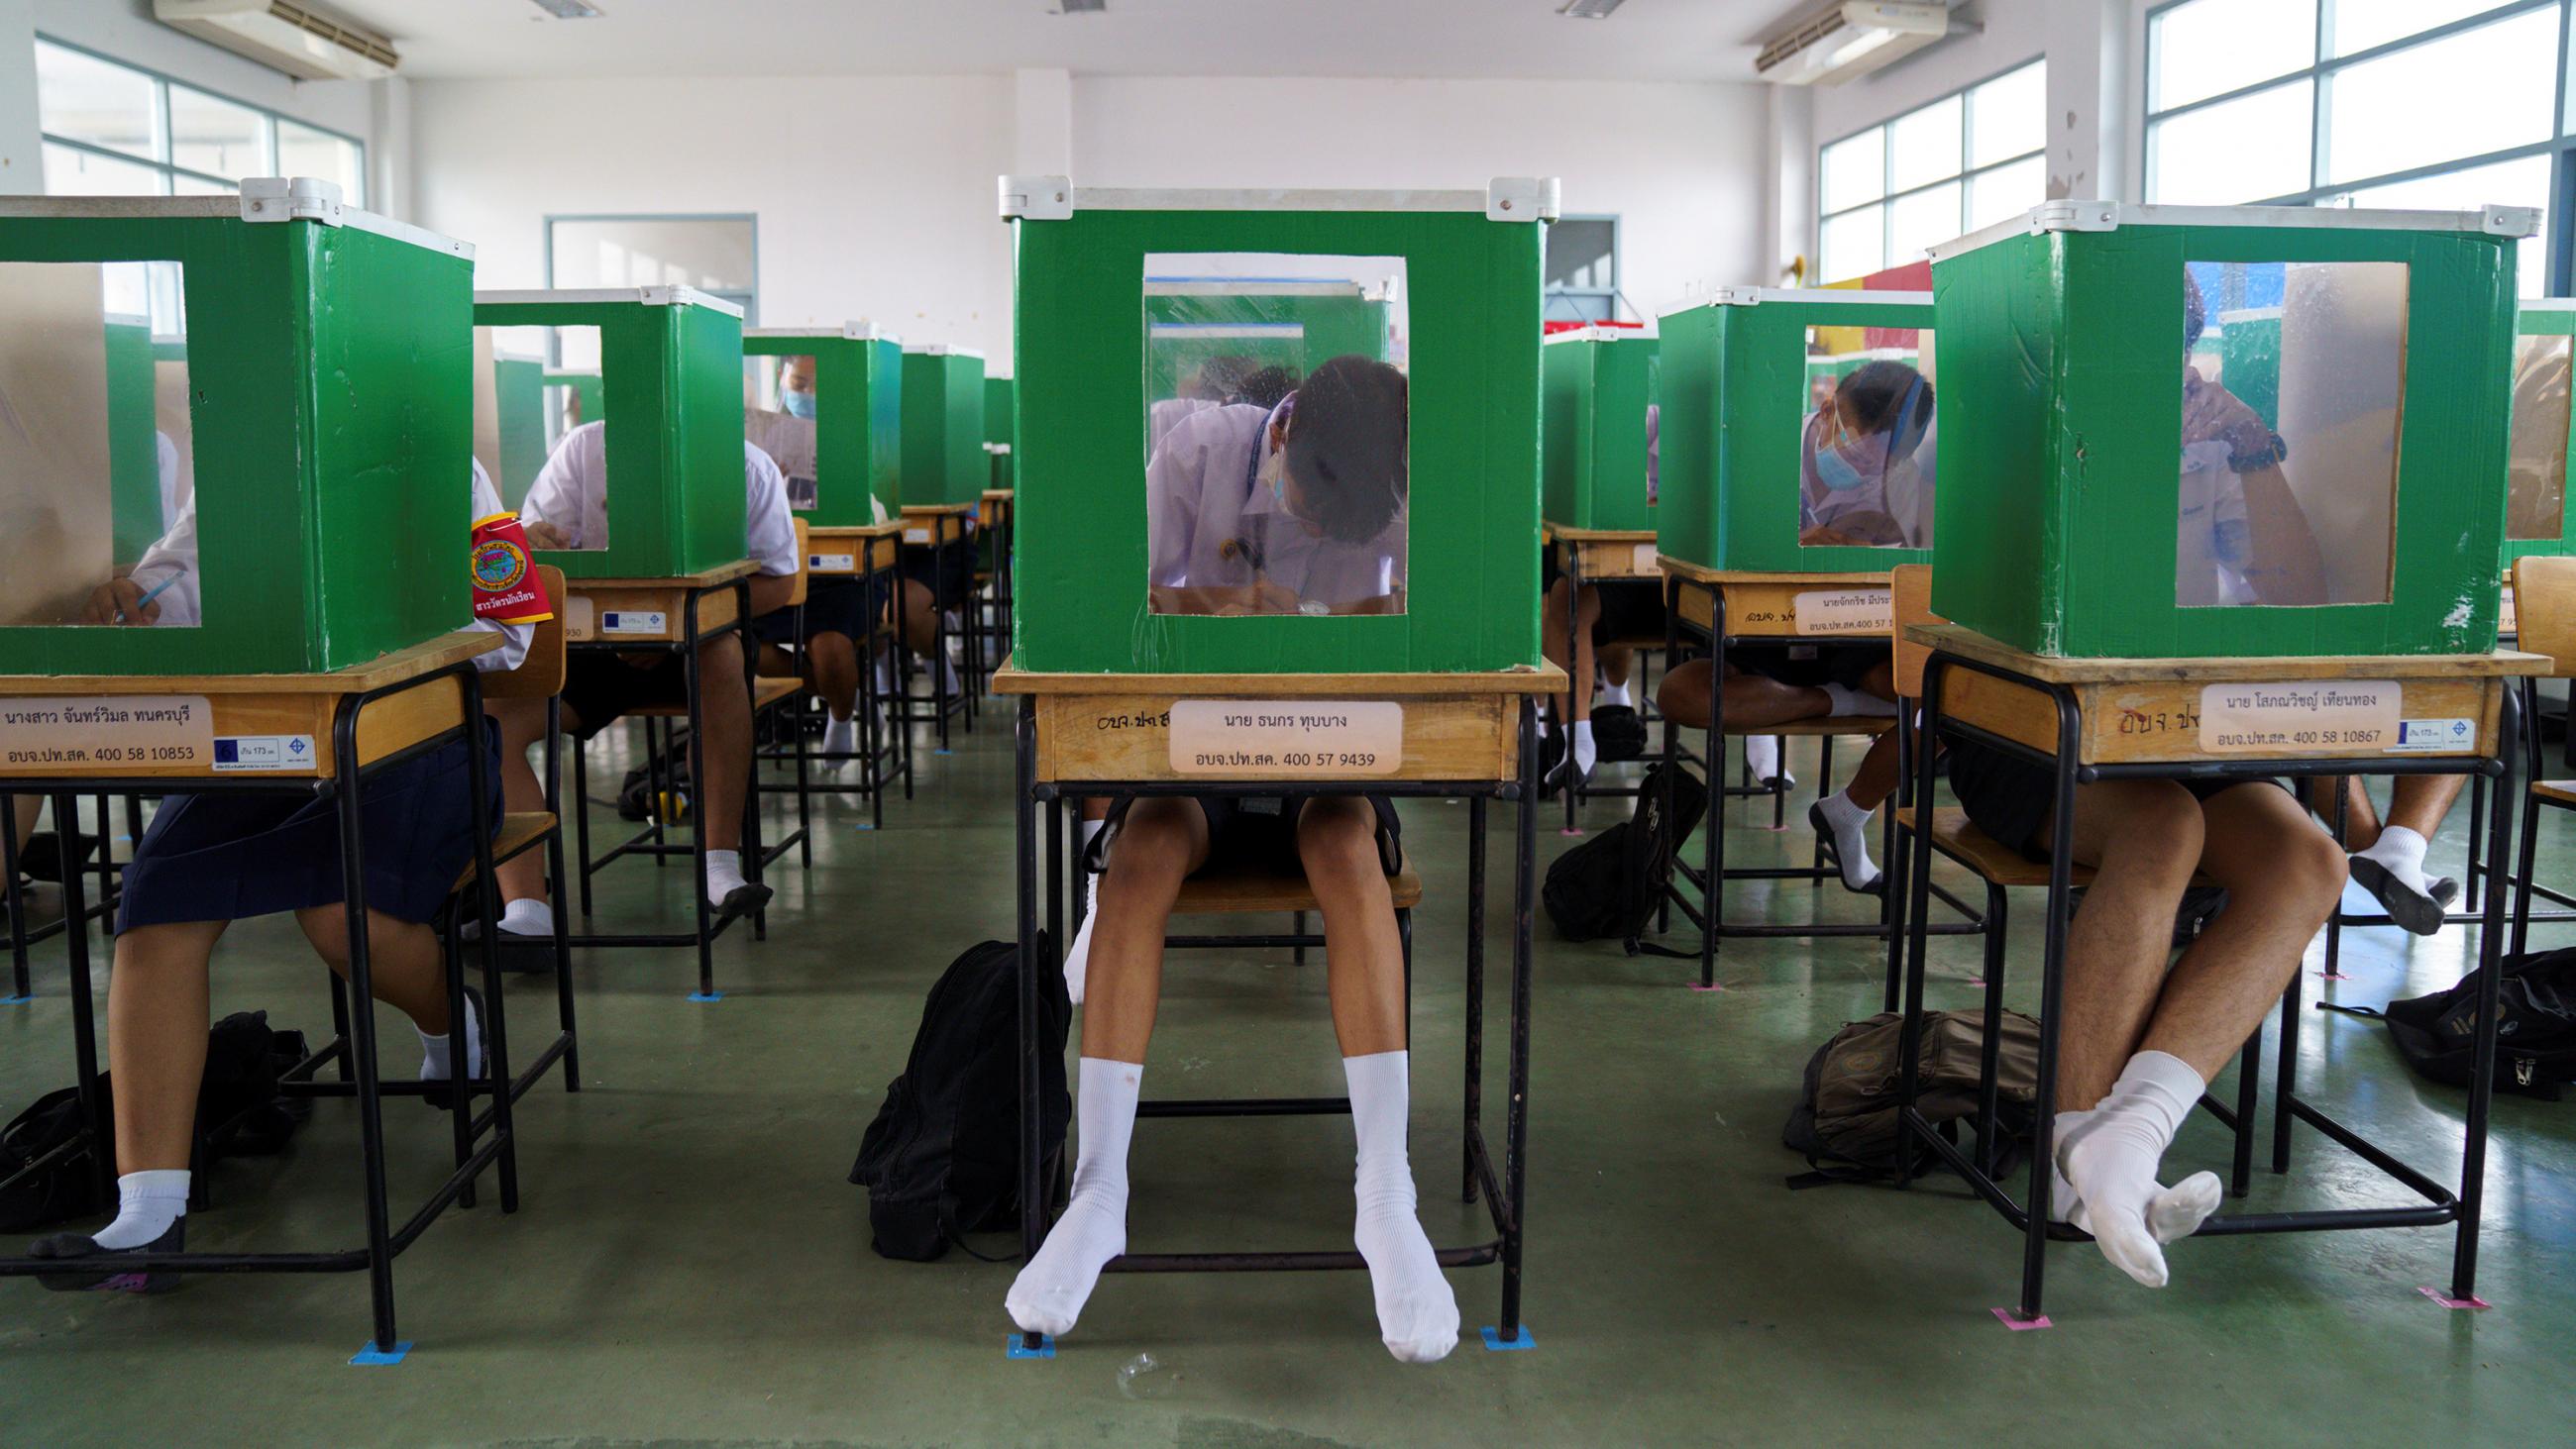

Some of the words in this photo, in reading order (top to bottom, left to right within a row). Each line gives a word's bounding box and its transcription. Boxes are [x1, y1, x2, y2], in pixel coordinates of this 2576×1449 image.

[1869, 594, 1891, 605] มีประ
[2227, 696, 2251, 708] นาย
[2255, 690, 2318, 711] โสภณวิชญ์
[2322, 690, 2377, 707] เทียนทอง
[5, 711, 58, 724] นางสาว
[63, 705, 129, 724] จันทร์วิมล
[134, 704, 190, 727] ทนครบุรี
[1225, 715, 1252, 727] นาย
[1258, 715, 1294, 727] ธนกร
[1300, 715, 1347, 733] ทุบบาง
[2217, 731, 2289, 746] อบจ.ปท.สค.
[2294, 731, 2317, 744] 400
[2322, 731, 2337, 743] 58
[2343, 730, 2381, 743] 10867
[8, 748, 90, 763] อบจ.ปท.สค.
[95, 748, 122, 762] 400
[128, 748, 145, 761] 58
[151, 747, 194, 761] 10853
[1196, 751, 1278, 766] อบจ.ปท.สค.
[1283, 753, 1311, 766] 400
[1316, 753, 1334, 766] 57
[1340, 753, 1375, 766] 9439
